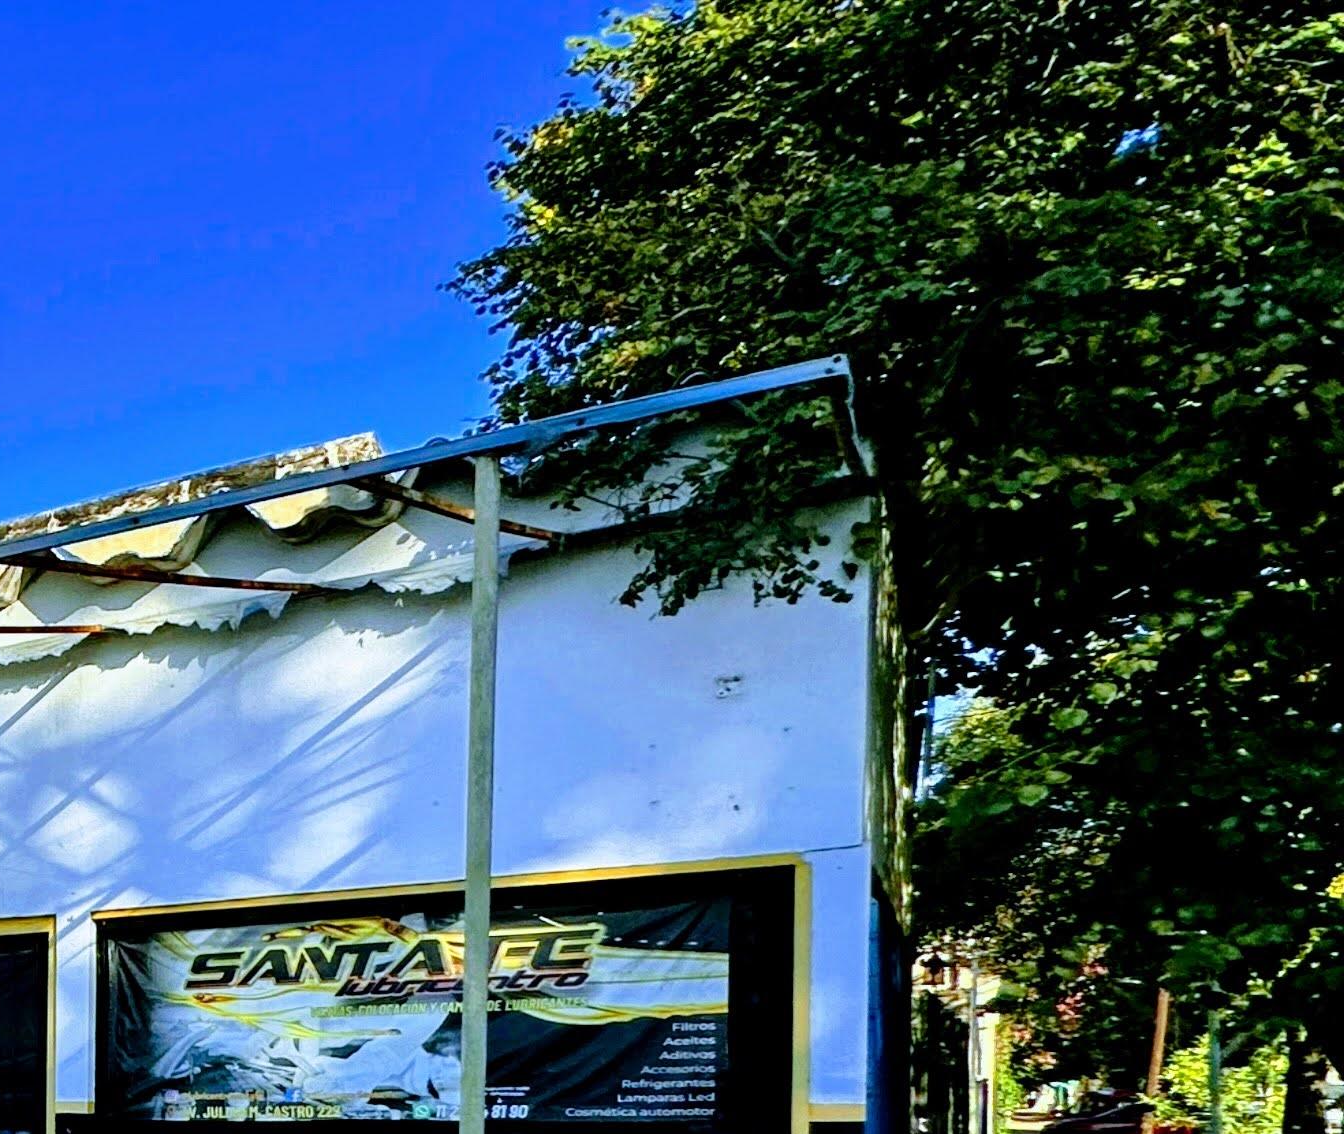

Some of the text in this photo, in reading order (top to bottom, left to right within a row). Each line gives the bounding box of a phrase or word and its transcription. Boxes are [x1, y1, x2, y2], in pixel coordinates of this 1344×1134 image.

[185, 936, 446, 990] SANTA
[335, 970, 590, 998] lubricntro
[672, 1022, 717, 1031] Filtros
[663, 1036, 717, 1046] Aceites
[659, 1051, 717, 1060] Aditivos
[640, 1065, 716, 1074] Accesorios
[622, 1078, 716, 1090] Refrigerantes
[617, 1092, 716, 1104] Lamparas Led
[265, 1105, 313, 1119] CASTRO
[565, 1106, 716, 1117] Cosmética automotor
